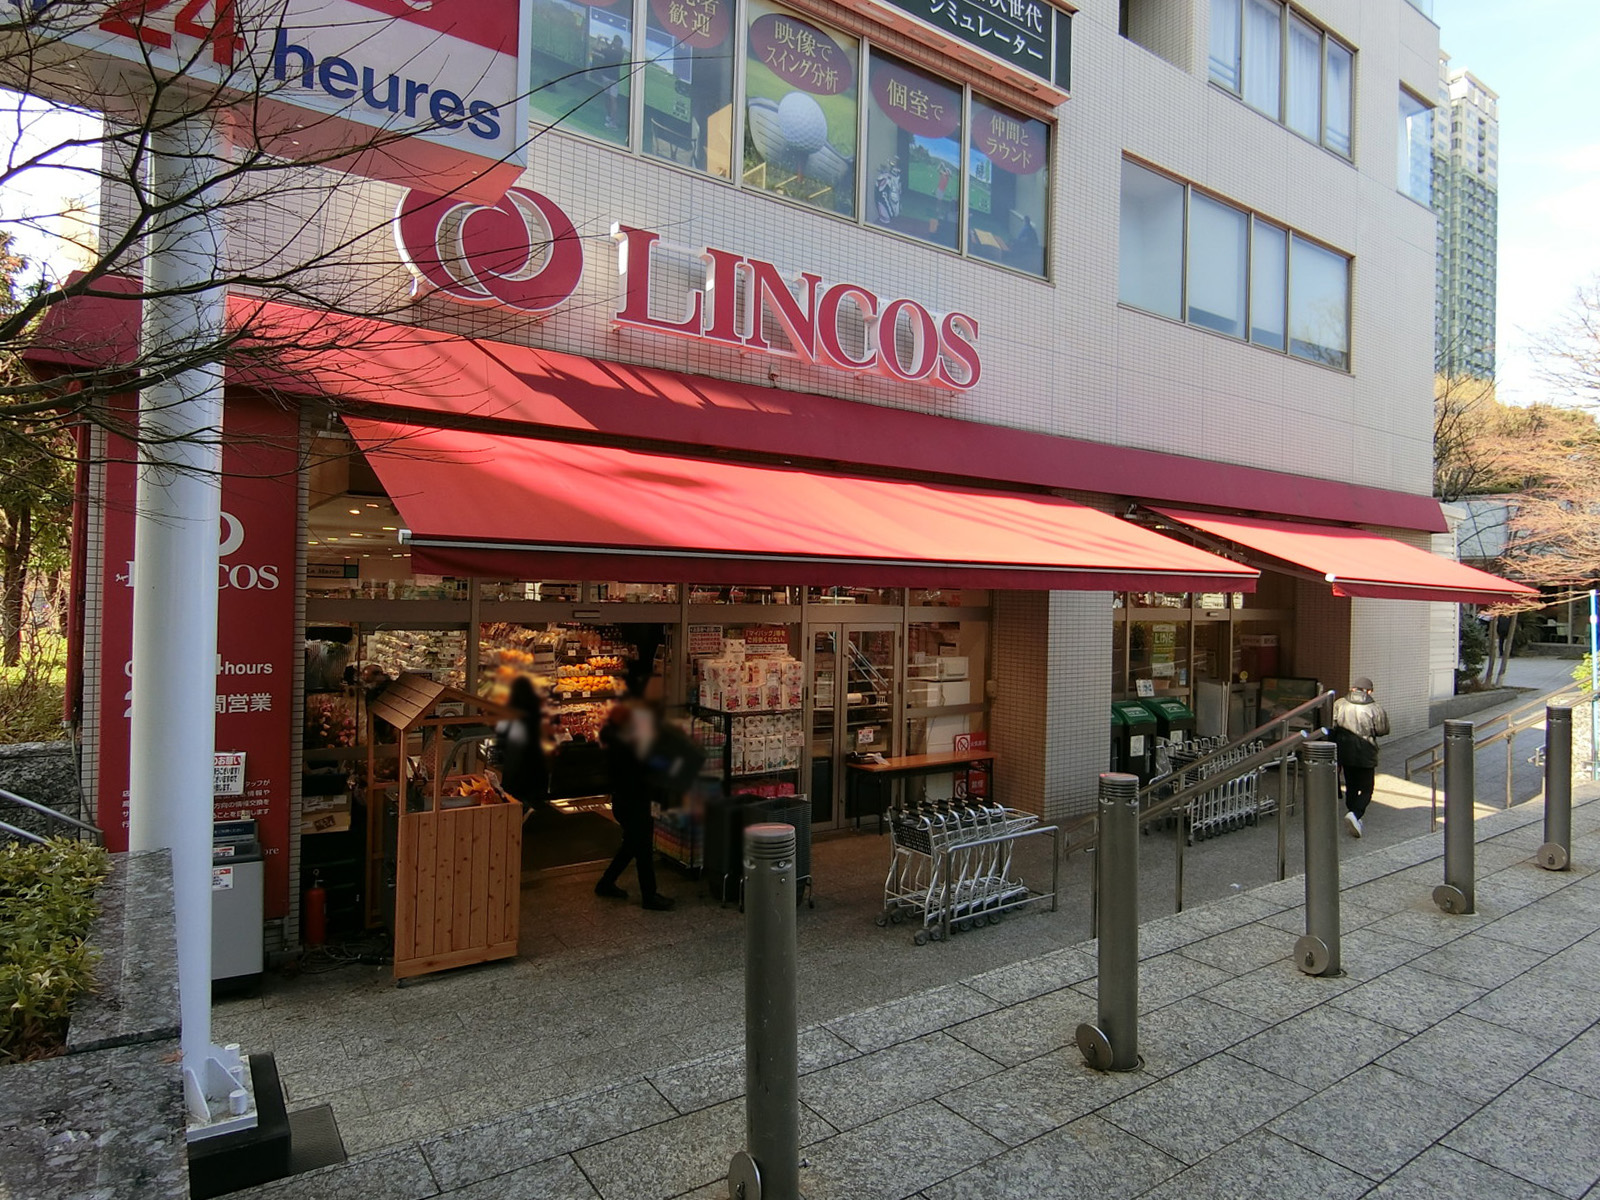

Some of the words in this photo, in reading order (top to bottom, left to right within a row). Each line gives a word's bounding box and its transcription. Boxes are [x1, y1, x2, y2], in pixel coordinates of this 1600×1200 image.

[669, 1, 711, 38] 歓迎
[774, 20, 833, 62] 映像で
[273, 27, 501, 140] heures
[764, 45, 839, 94] スイング分析
[886, 78, 945, 121] 個室で
[989, 114, 1030, 147] 仲間と
[985, 137, 1033, 169] ラウンド
[611, 222, 982, 391] LINCOS
